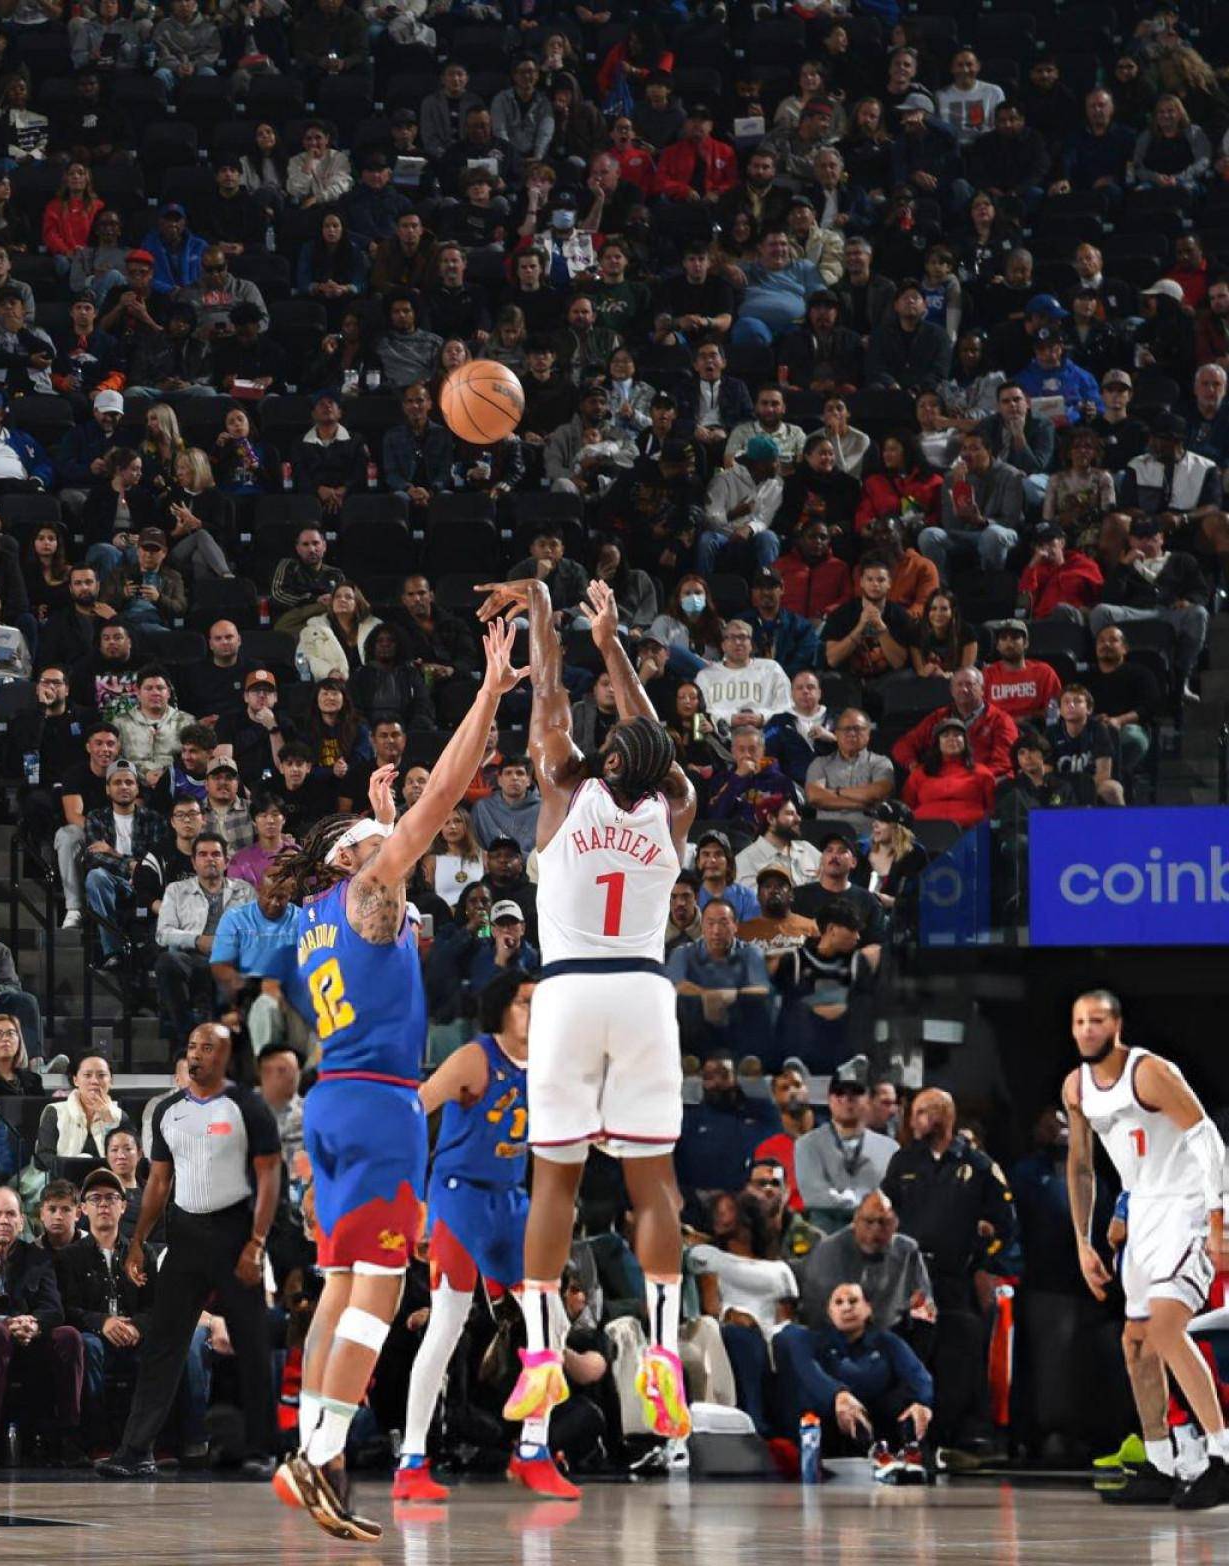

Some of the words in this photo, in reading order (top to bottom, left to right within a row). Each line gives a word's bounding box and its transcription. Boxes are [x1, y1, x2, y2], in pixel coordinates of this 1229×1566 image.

[991, 682, 1036, 701] CLIPPERS
[572, 826, 662, 865] HARDEN
[596, 872, 625, 936] 1
